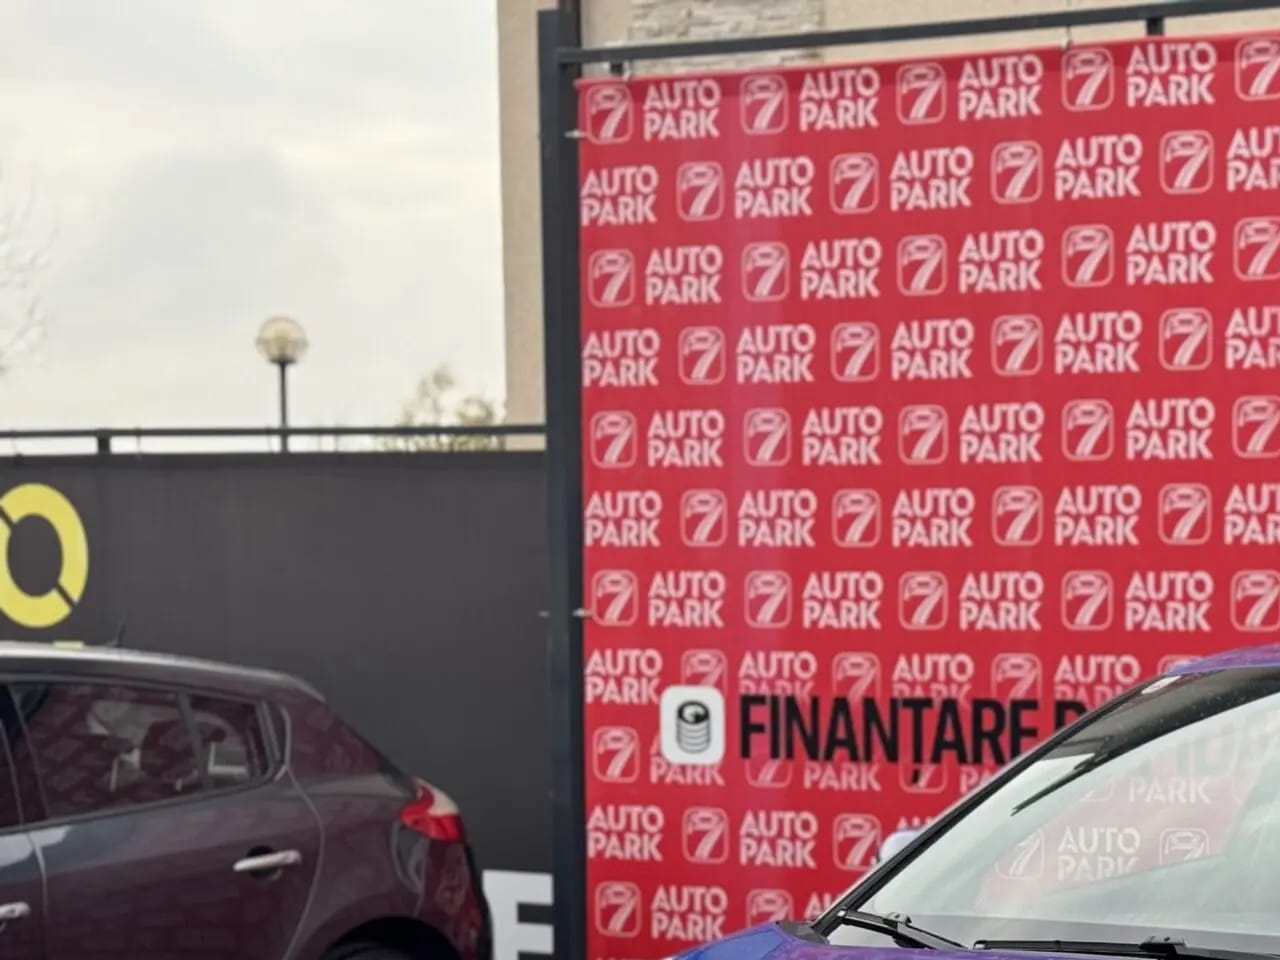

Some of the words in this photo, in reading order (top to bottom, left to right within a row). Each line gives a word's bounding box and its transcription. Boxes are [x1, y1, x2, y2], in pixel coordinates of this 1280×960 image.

[958, 54, 1043, 90] AUTO
[1126, 42, 1216, 75] AUTO
[643, 80, 720, 112] AUTO
[800, 68, 879, 101] AUTO
[1127, 73, 1214, 107] PARK
[800, 96, 878, 131] PARK
[958, 84, 1041, 120] PARK
[644, 107, 719, 141] PARK
[890, 146, 974, 181] AUTO
[1055, 134, 1143, 170] AUTO
[581, 165, 658, 197] AUTO
[734, 156, 814, 190] AUTO
[1055, 164, 1140, 200] PARK
[735, 185, 812, 219] PARK
[891, 176, 971, 211] PARK
[581, 193, 656, 226] PARK
[959, 229, 1044, 264] AUTO
[1126, 220, 1216, 254] AUTO
[646, 245, 723, 276] AUTO
[801, 237, 881, 270] AUTO
[1127, 251, 1213, 285] PARK
[646, 273, 721, 305] PARK
[801, 266, 879, 299] PARK
[959, 259, 1041, 293] PARK
[736, 324, 816, 356] AUTO
[891, 318, 974, 351] AUTO
[1055, 310, 1142, 344] AUTO
[583, 328, 660, 358] AUTO
[1055, 341, 1139, 374] PARK
[583, 357, 658, 387] PARK
[737, 353, 813, 383] PARK
[892, 348, 972, 380] PARK
[648, 410, 724, 440] AUTO
[802, 406, 883, 436] AUTO
[960, 402, 1044, 433] AUTO
[1126, 397, 1215, 429] AUTO
[648, 438, 723, 467] PARK
[803, 435, 880, 465] PARK
[960, 431, 1041, 463] PARK
[1127, 428, 1212, 460] PARK
[585, 490, 662, 519] AUTO
[738, 489, 817, 518] AUTO
[892, 488, 974, 518] AUTO
[1055, 485, 1141, 515] AUTO
[585, 518, 660, 546] PARK
[738, 517, 815, 547] PARK
[893, 517, 972, 547] PARK
[1055, 514, 1138, 545] PARK
[648, 571, 725, 599] AUTO
[803, 571, 883, 600] AUTO
[960, 571, 1043, 601] AUTO
[1126, 571, 1213, 602] AUTO
[649, 597, 723, 627] PARK
[803, 599, 880, 629] PARK
[960, 600, 1041, 630] PARK
[1125, 600, 1210, 631] PARK
[585, 649, 662, 677] AUTO
[739, 651, 817, 679] AUTO
[893, 654, 973, 682] AUTO
[1055, 655, 1140, 684] AUTO
[586, 675, 660, 705] PARK
[1127, 772, 1211, 804] PARK
[587, 806, 664, 833] AUTO
[740, 811, 817, 839] AUTO
[588, 830, 661, 860] PARK
[740, 836, 815, 867] PARK
[1058, 826, 1142, 855] AUTO
[653, 887, 727, 914] AUTO
[653, 912, 724, 941] PARK
